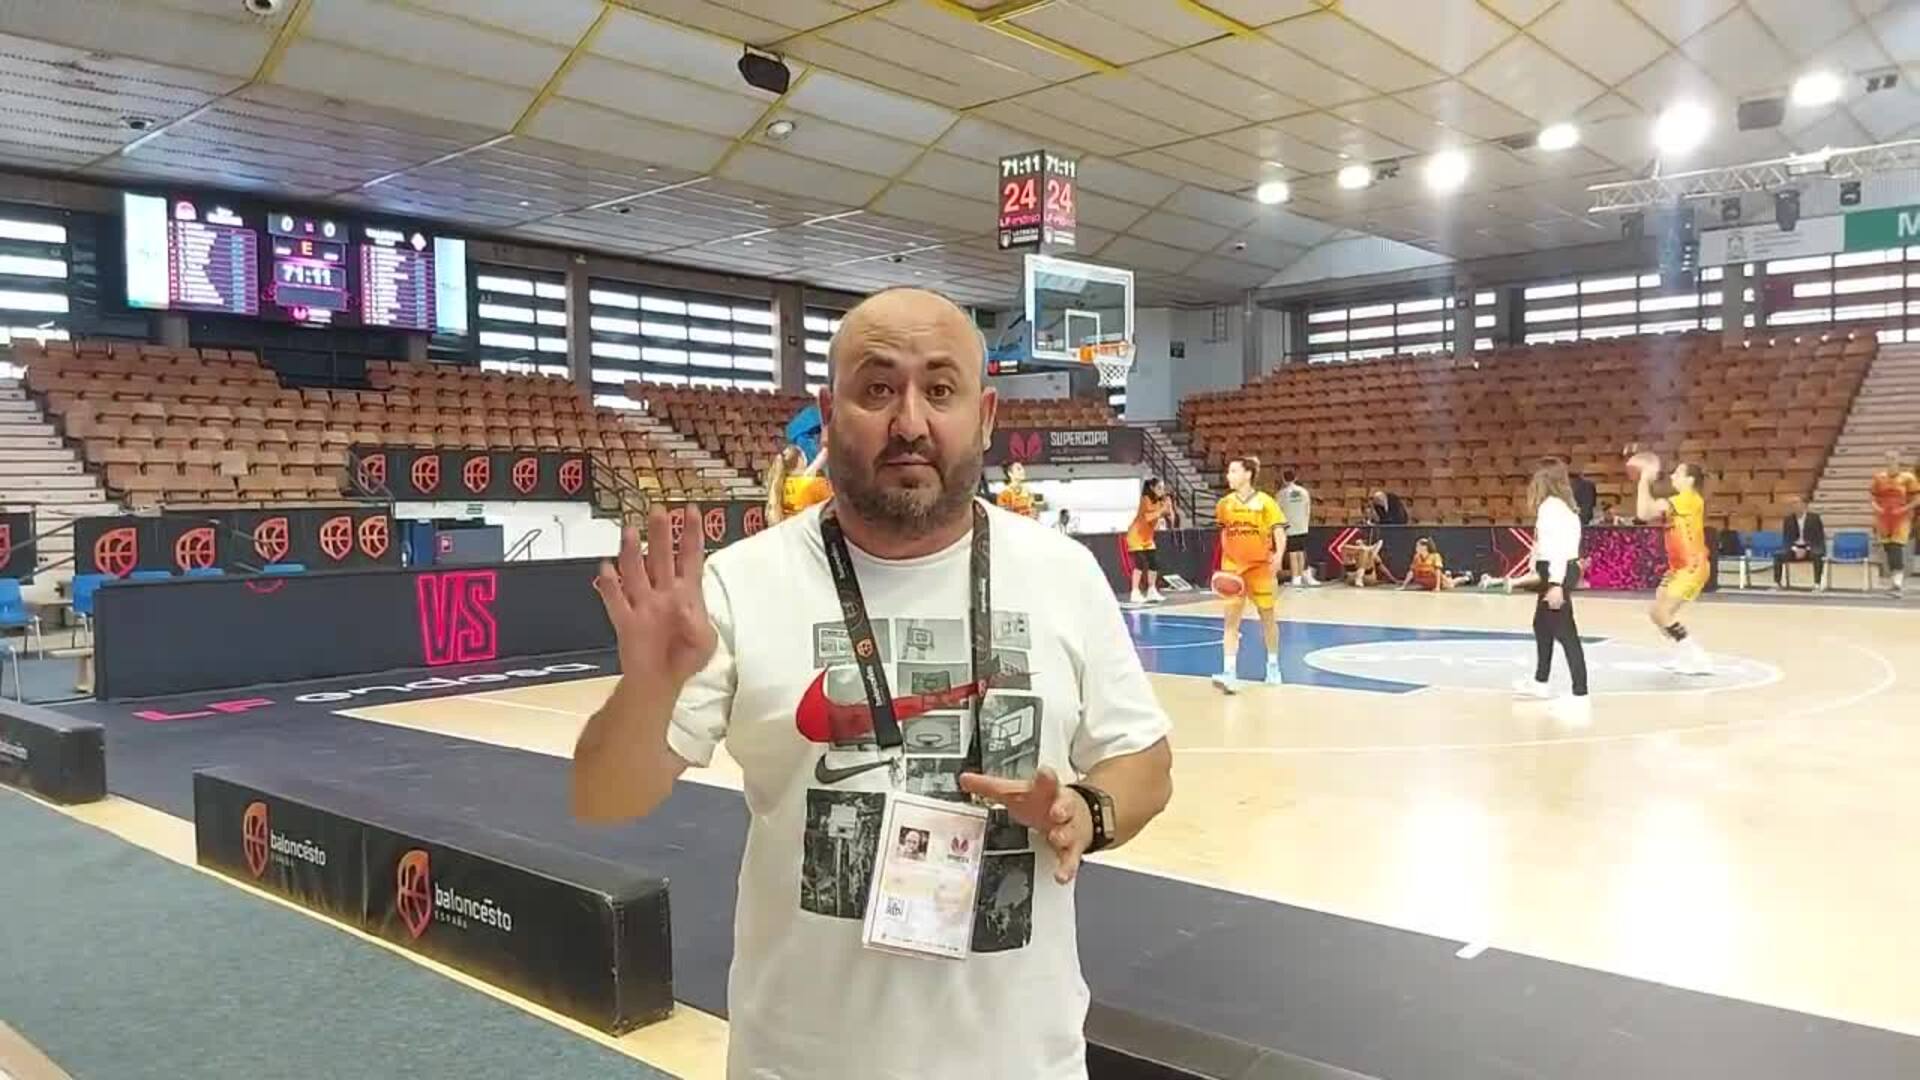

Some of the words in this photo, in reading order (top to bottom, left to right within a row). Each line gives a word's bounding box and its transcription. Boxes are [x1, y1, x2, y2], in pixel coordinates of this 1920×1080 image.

[1001, 155, 1040, 177] 71:11
[1003, 178, 1037, 213] 24
[1047, 179, 1073, 213] 24
[281, 215, 294, 232] 0
[323, 221, 336, 237] 0
[301, 241, 313, 256] E
[282, 264, 331, 286] 71:11
[1050, 431, 1108, 446] SUPERCOPA
[417, 570, 496, 666] VS
